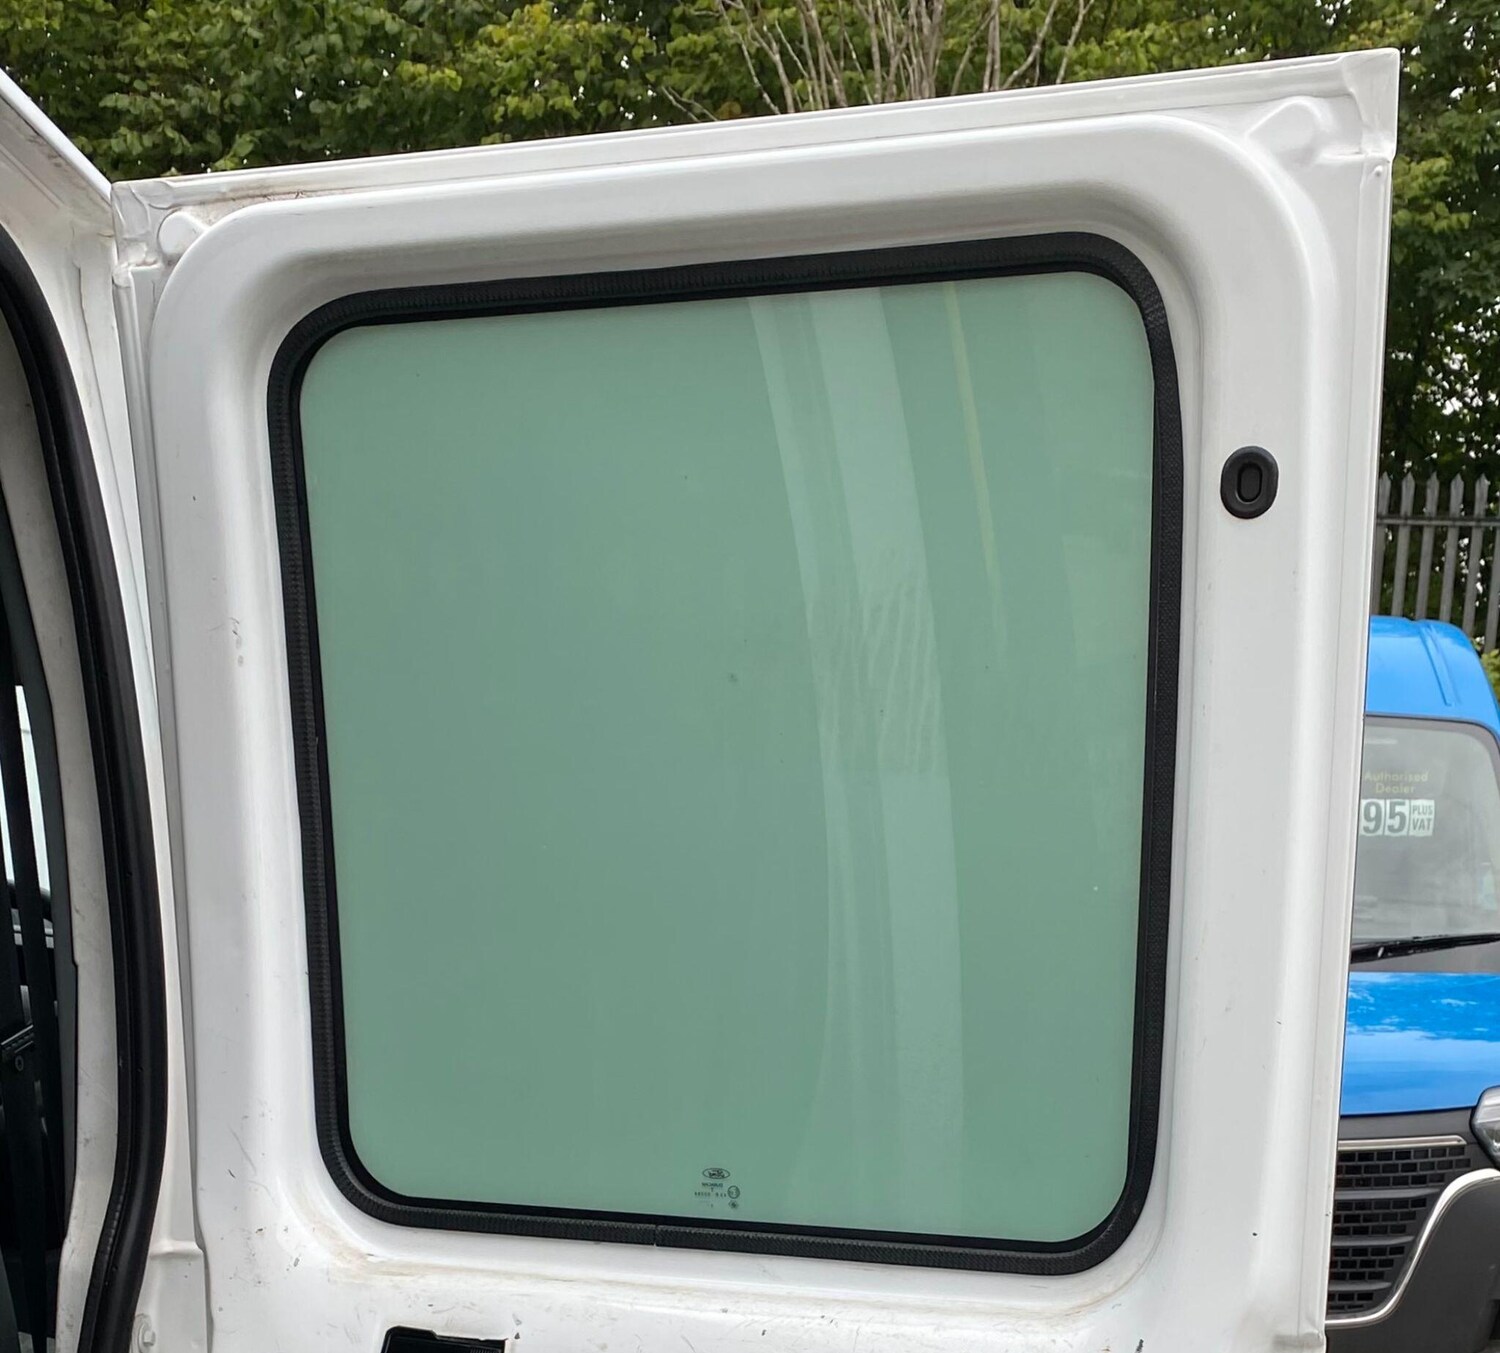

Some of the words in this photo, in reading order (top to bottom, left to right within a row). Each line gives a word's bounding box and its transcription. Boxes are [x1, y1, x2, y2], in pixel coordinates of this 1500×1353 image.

[1364, 770, 1429, 782] Authorised
[1375, 783, 1415, 794] Dealer
[1412, 804, 1434, 816] PLUS
[1412, 818, 1432, 831] VAT
